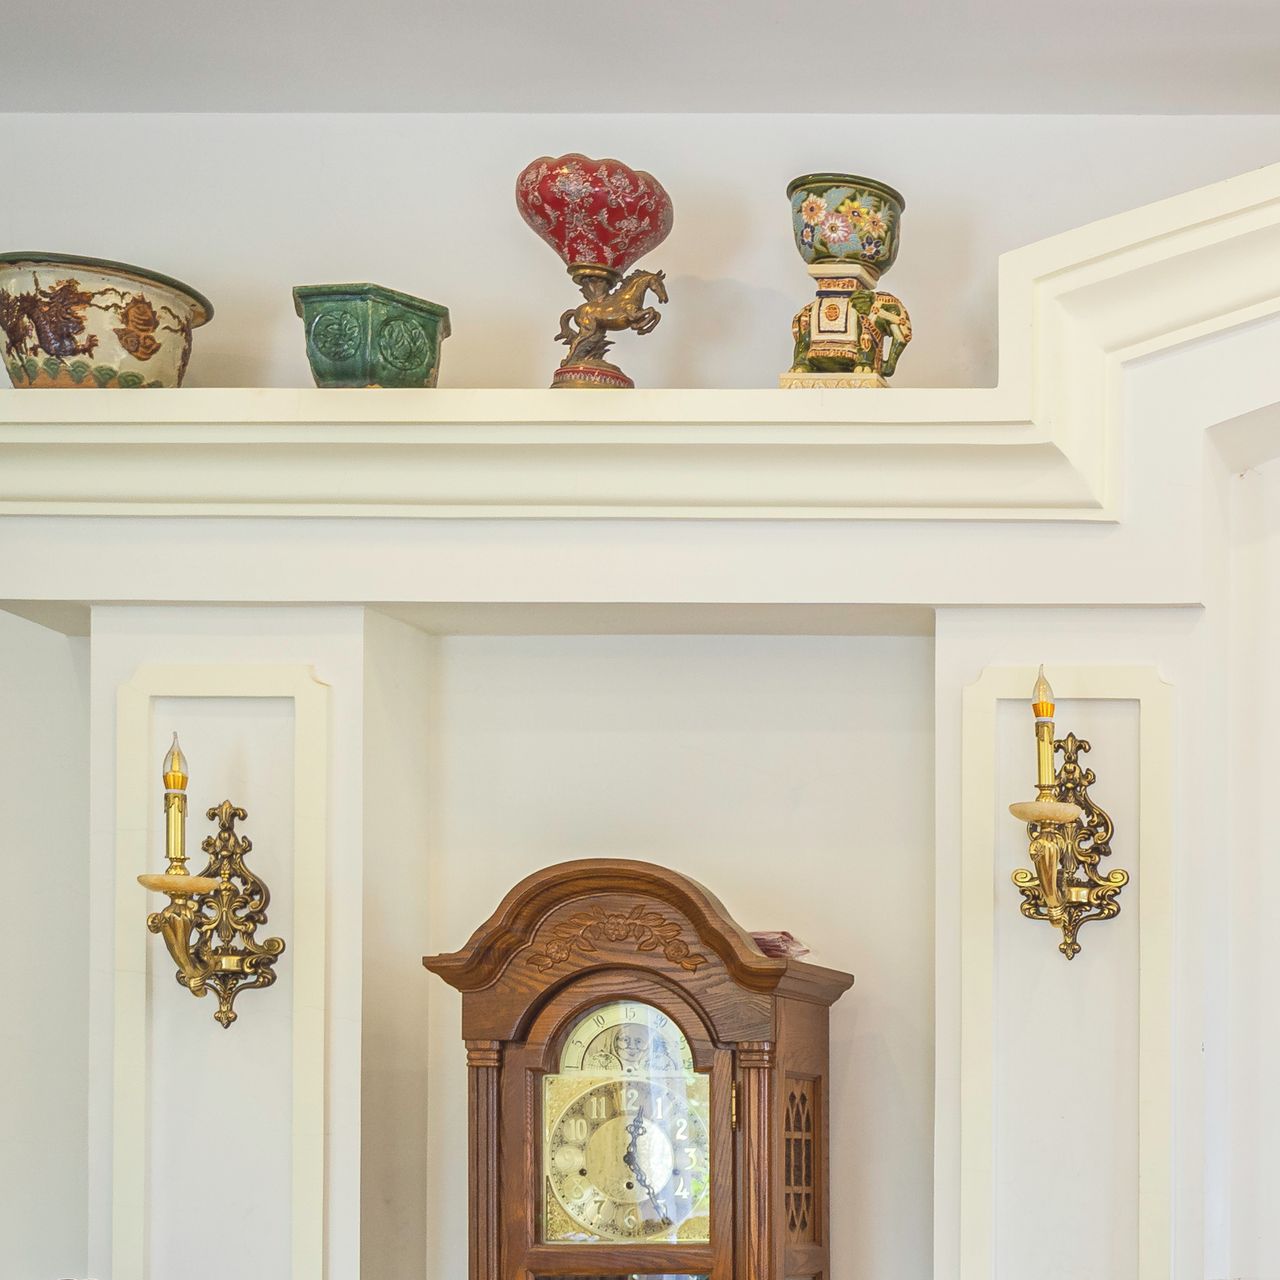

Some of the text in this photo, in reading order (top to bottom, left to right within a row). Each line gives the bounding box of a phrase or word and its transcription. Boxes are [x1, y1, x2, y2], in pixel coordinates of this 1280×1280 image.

[593, 1015, 605, 1028] 10
[625, 1007, 636, 1019] 15
[589, 1097, 607, 1119] 11
[620, 1088, 639, 1111] 12
[655, 1097, 663, 1119] 1
[569, 1118, 588, 1141] 10
[676, 1118, 688, 1140] 2
[684, 1147, 697, 1170] 3
[572, 1177, 586, 1200] 8
[674, 1177, 689, 1199] 4
[590, 1199, 607, 1223] 7
[624, 1207, 638, 1230] 6
